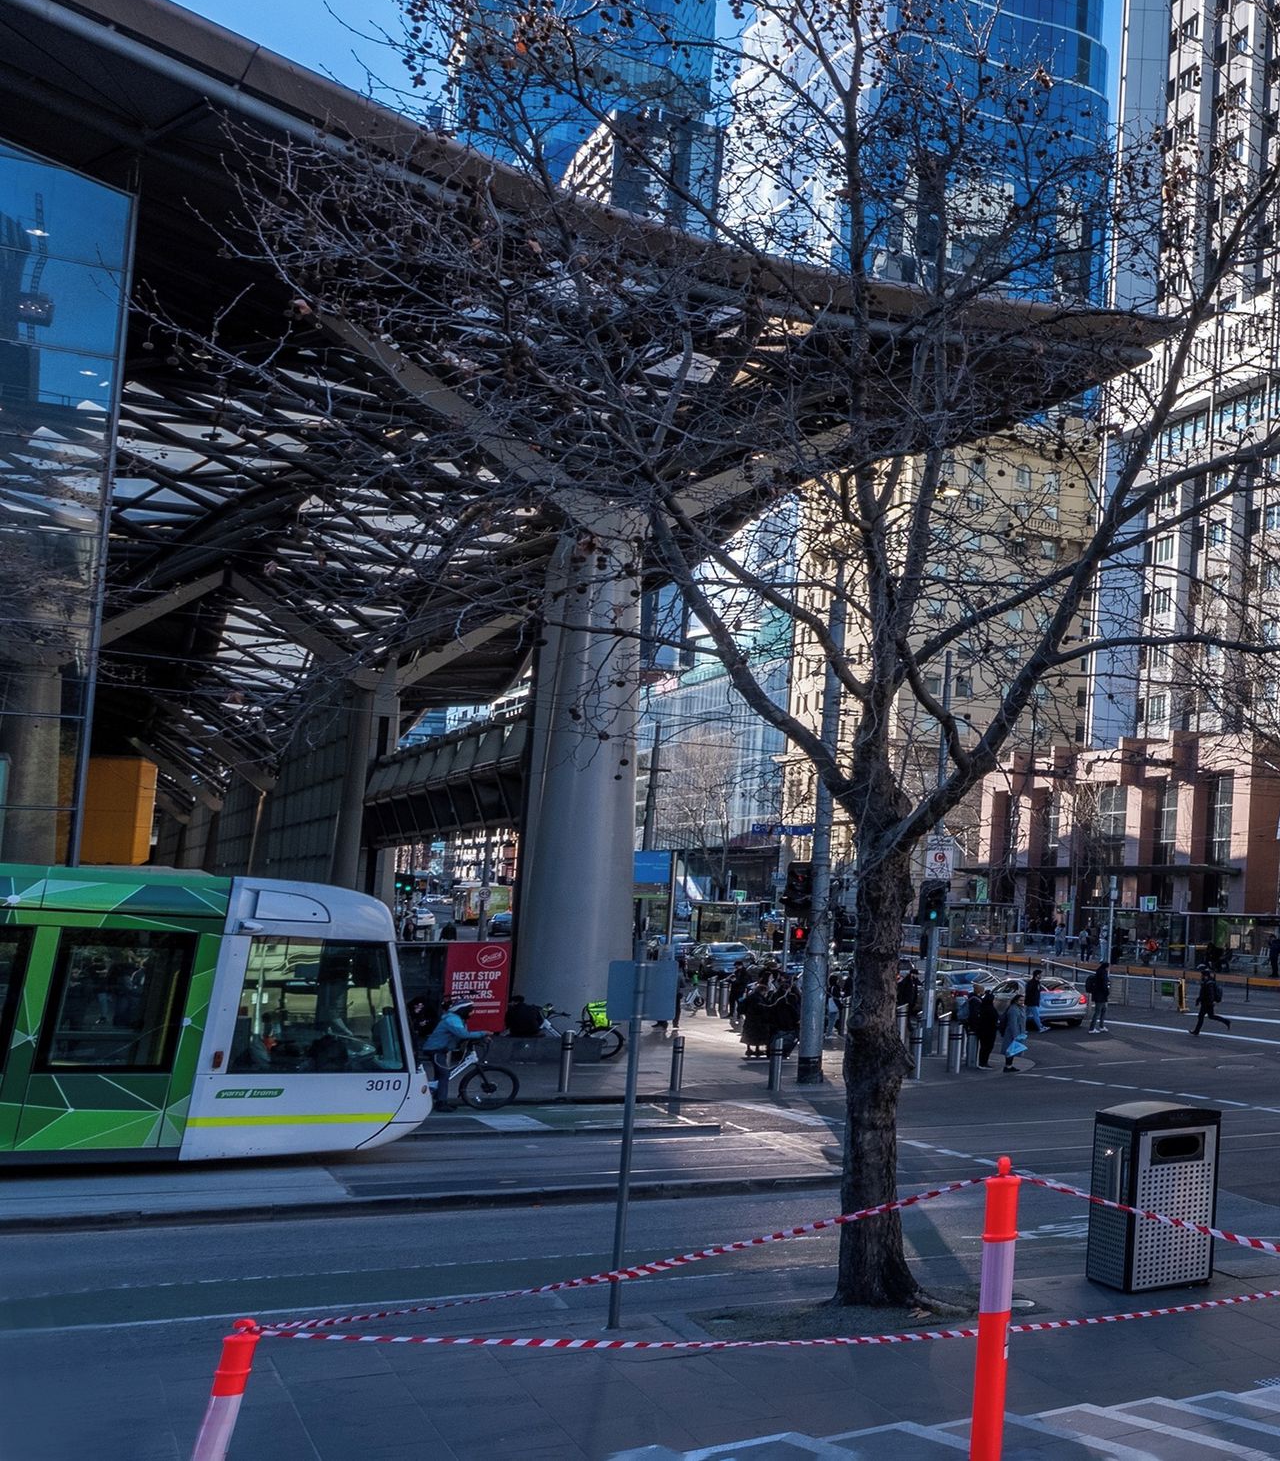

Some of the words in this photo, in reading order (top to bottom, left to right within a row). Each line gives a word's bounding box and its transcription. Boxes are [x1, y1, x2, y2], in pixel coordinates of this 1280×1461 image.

[452, 971, 477, 981] NEXT
[477, 971, 501, 980] STOP
[451, 980, 491, 990] HEALTHY
[365, 1079, 402, 1092] 3010
[220, 1089, 245, 1098] yarra
[252, 1089, 279, 1097] trams
